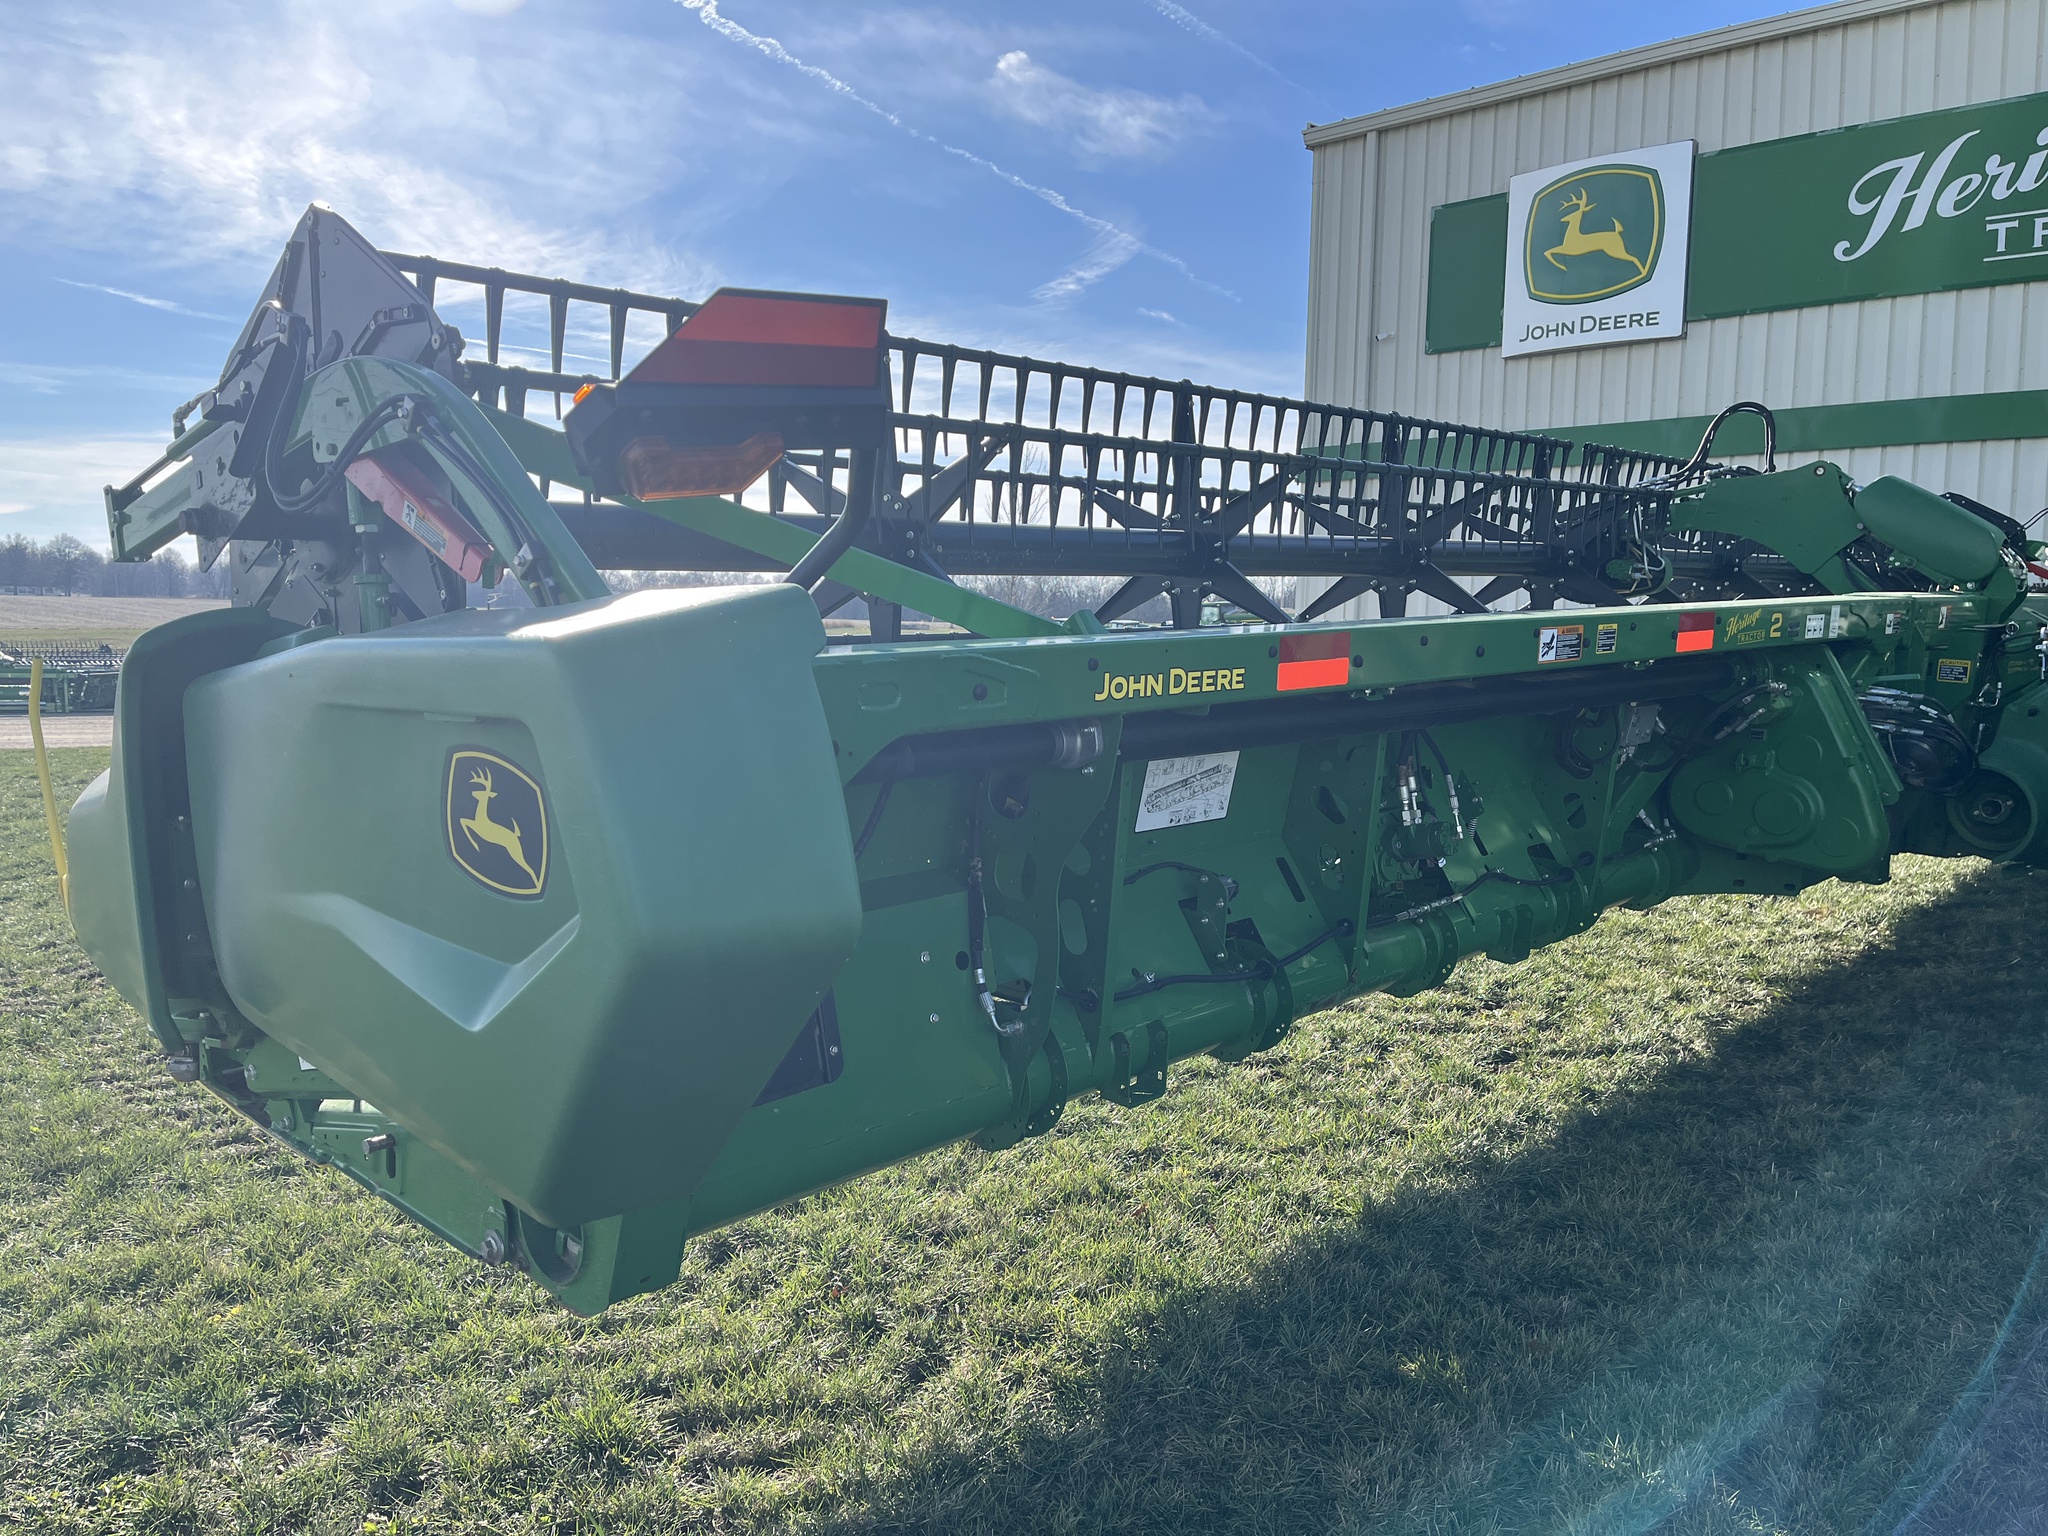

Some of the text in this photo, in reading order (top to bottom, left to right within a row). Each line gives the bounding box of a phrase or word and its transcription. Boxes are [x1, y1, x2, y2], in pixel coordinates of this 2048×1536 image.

[1519, 311, 1660, 343] JOHN DEERE
[1724, 608, 1762, 643] Heritage
[1737, 630, 1766, 643] TRACTOR
[1769, 612, 1783, 638] 2
[1094, 666, 1246, 702] JOHN DEERE
